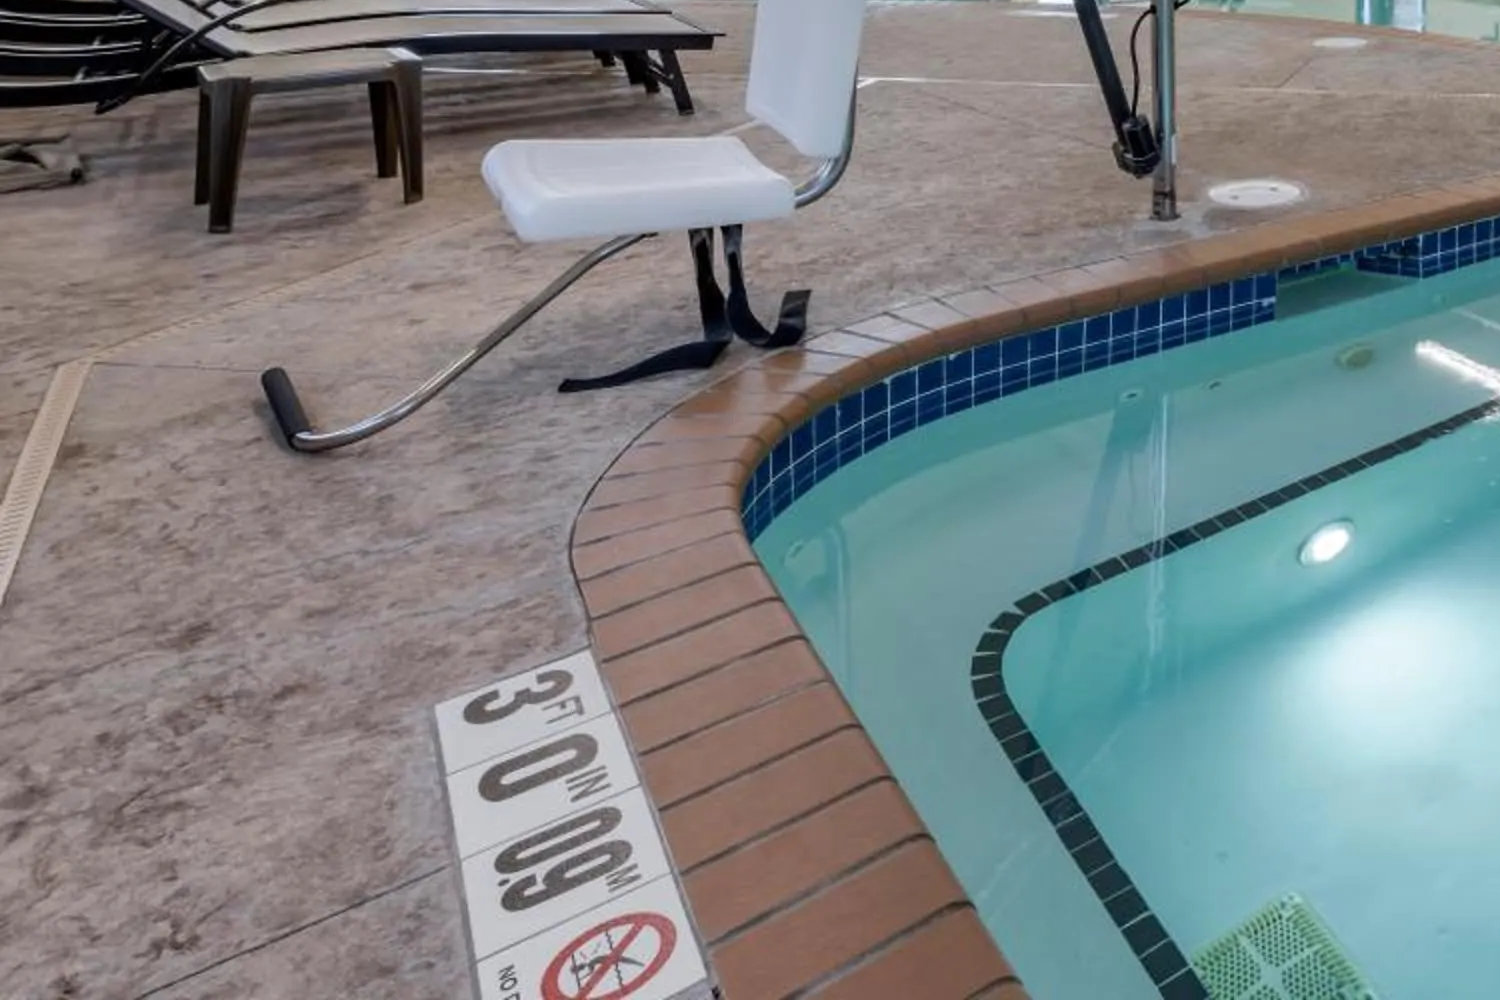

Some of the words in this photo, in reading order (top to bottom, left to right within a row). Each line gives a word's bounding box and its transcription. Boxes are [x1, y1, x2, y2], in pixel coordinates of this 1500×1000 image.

[463, 669, 574, 724] 3
[541, 695, 585, 724] FT
[478, 733, 599, 803] 0
[565, 765, 612, 803] IN
[494, 806, 633, 912] 0.9
[605, 862, 642, 893] M
[498, 963, 517, 991] NO
